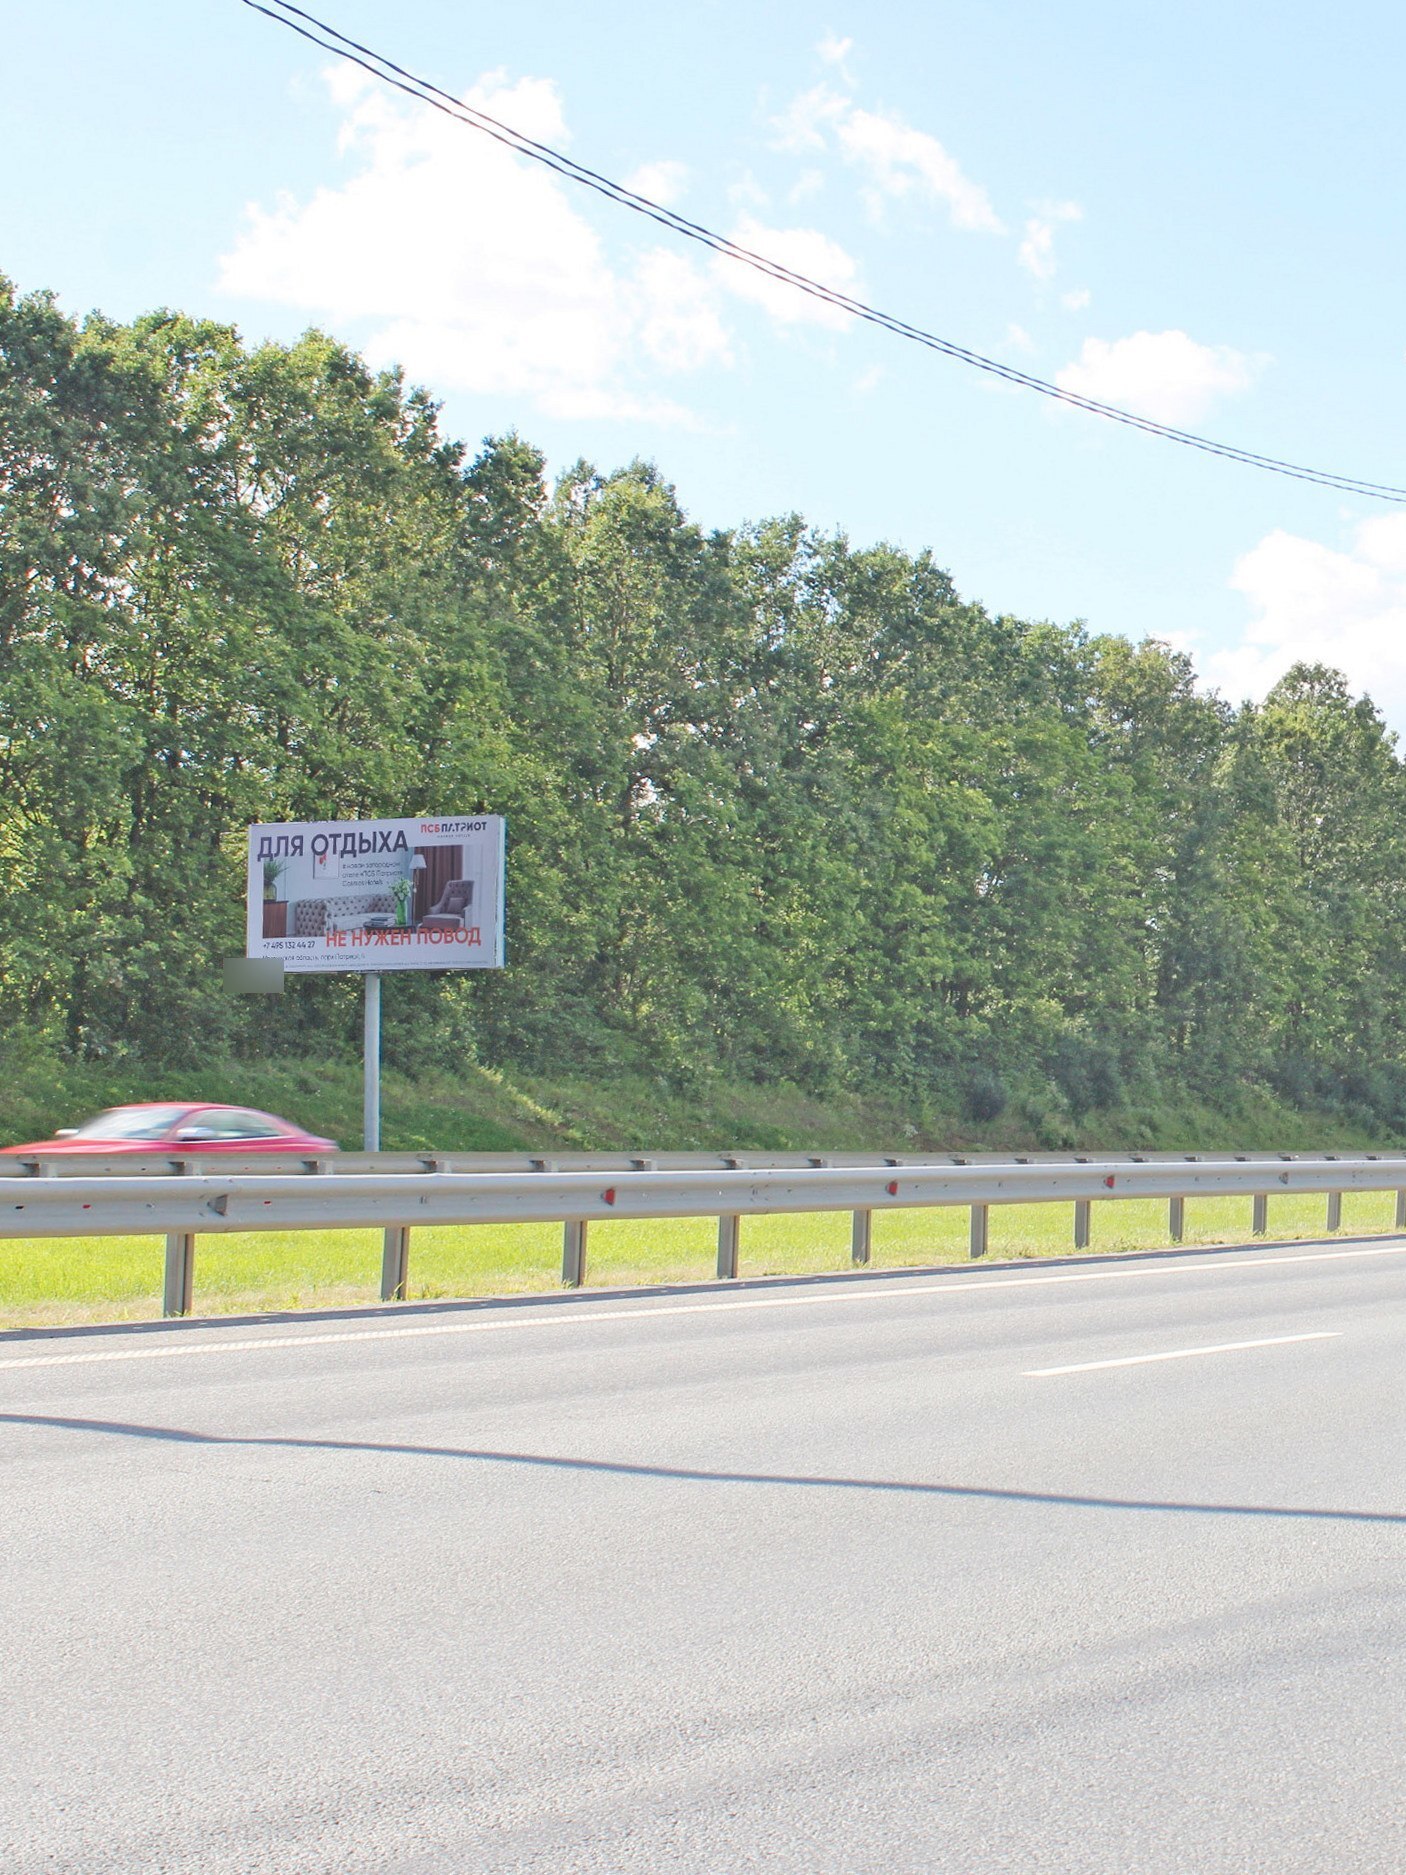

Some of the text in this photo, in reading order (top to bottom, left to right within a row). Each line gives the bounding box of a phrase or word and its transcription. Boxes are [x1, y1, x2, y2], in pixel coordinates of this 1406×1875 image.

[257, 829, 409, 862] ДЛЯ ОТДЫХА
[271, 941, 284, 949] 495
[326, 926, 482, 947] НЕ НУЖЕН ПОВОД
